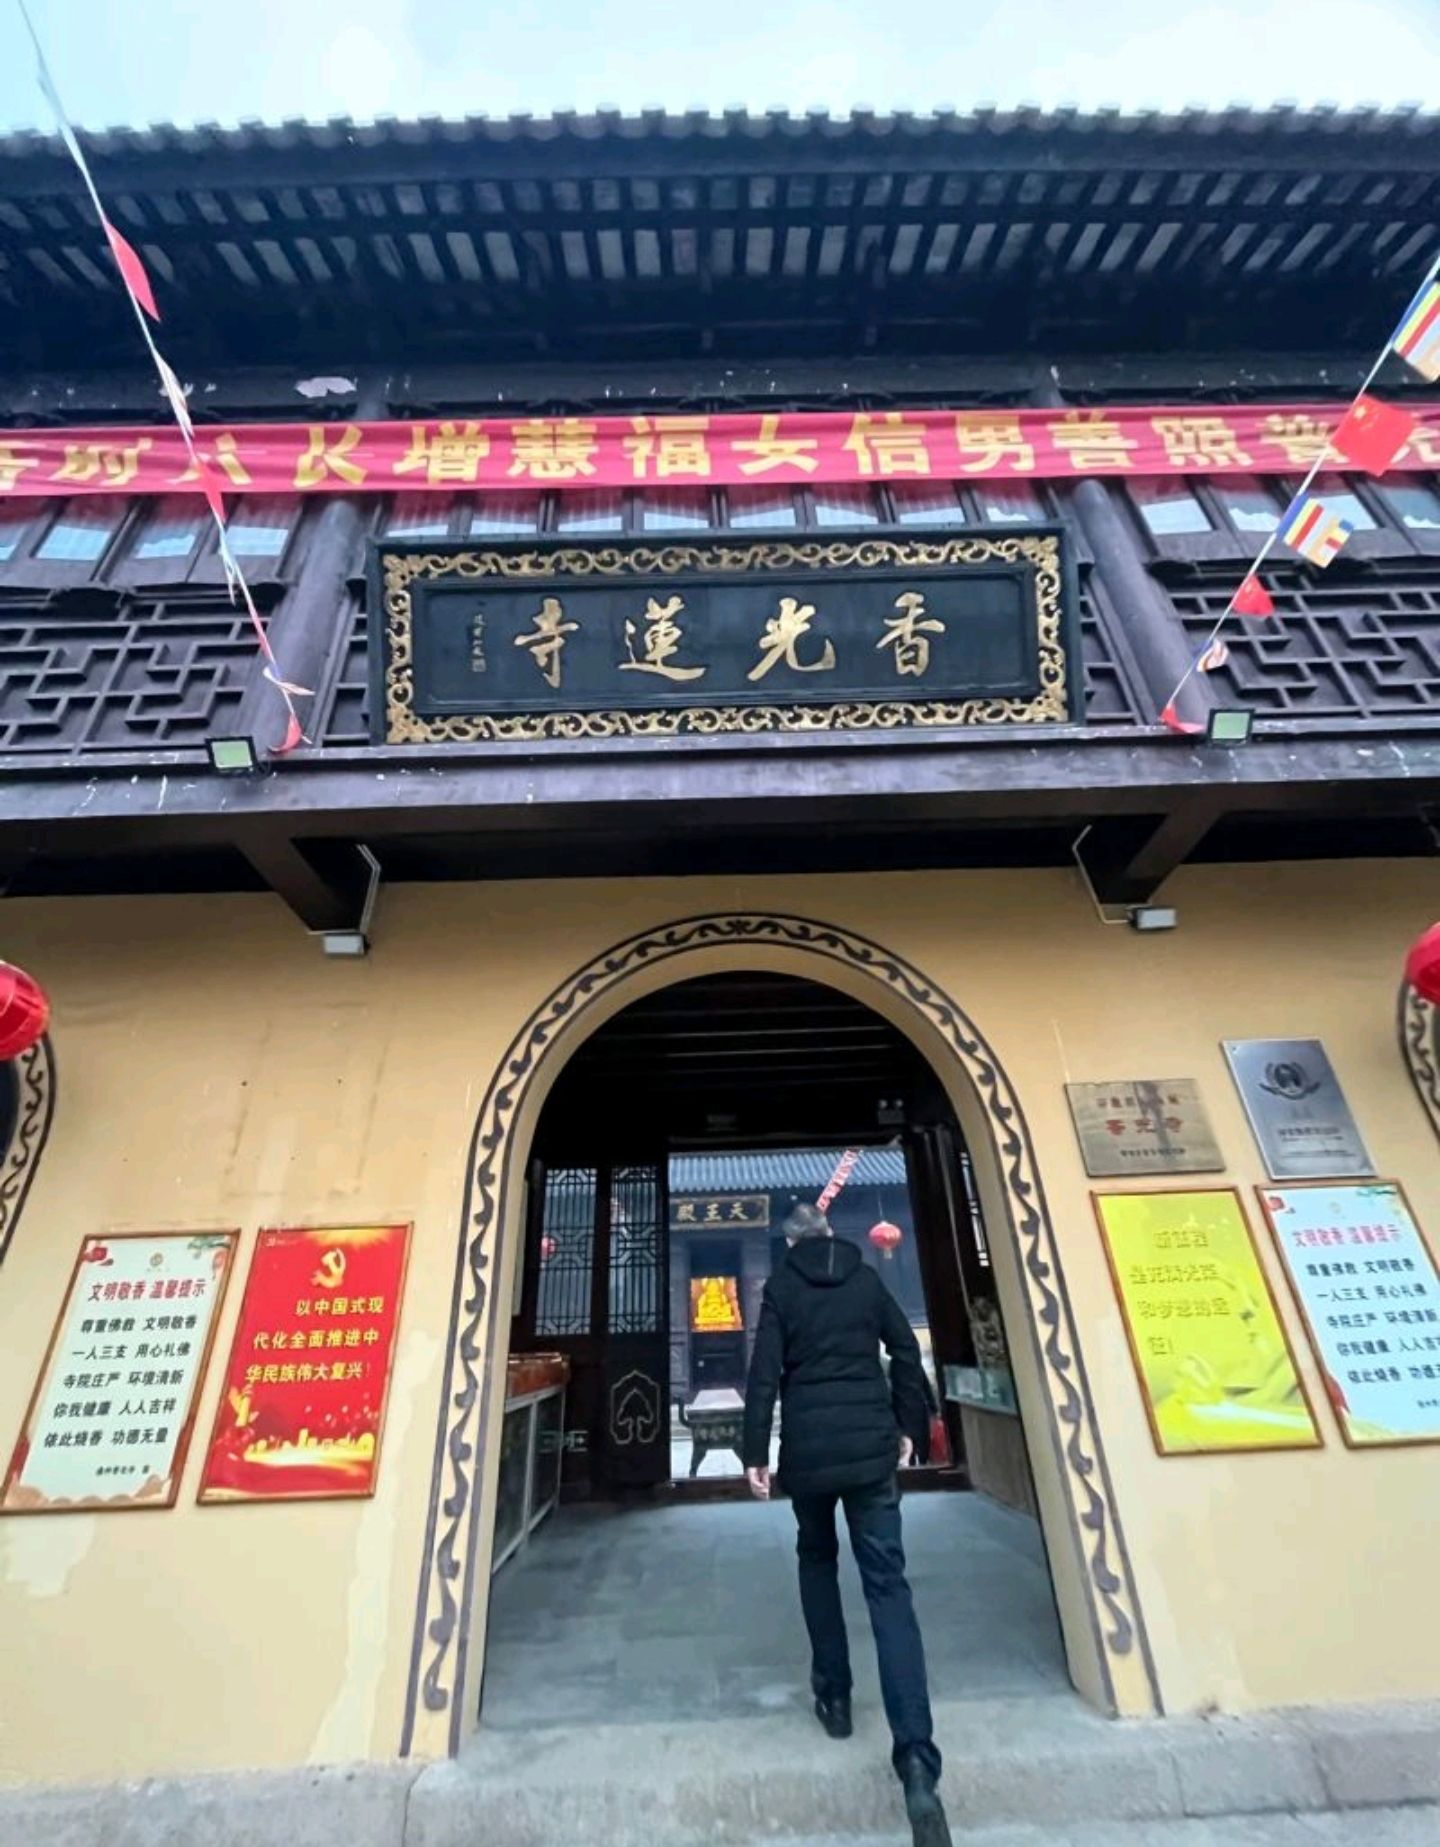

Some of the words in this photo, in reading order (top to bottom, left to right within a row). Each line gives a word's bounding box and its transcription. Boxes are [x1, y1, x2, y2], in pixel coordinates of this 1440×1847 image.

[88, 1280, 146, 1302] 文明敬香
[149, 1278, 206, 1299] 温馨提示
[296, 1296, 384, 1317] 以中国式现
[143, 1314, 197, 1331] 文明敬香
[253, 1326, 379, 1350] 代化全面推进中
[72, 1345, 128, 1360] 一人三支
[135, 1341, 191, 1358] 用心礼佛
[118, 1398, 177, 1415] 人人吉祥
[111, 1427, 168, 1445] 功德无量
